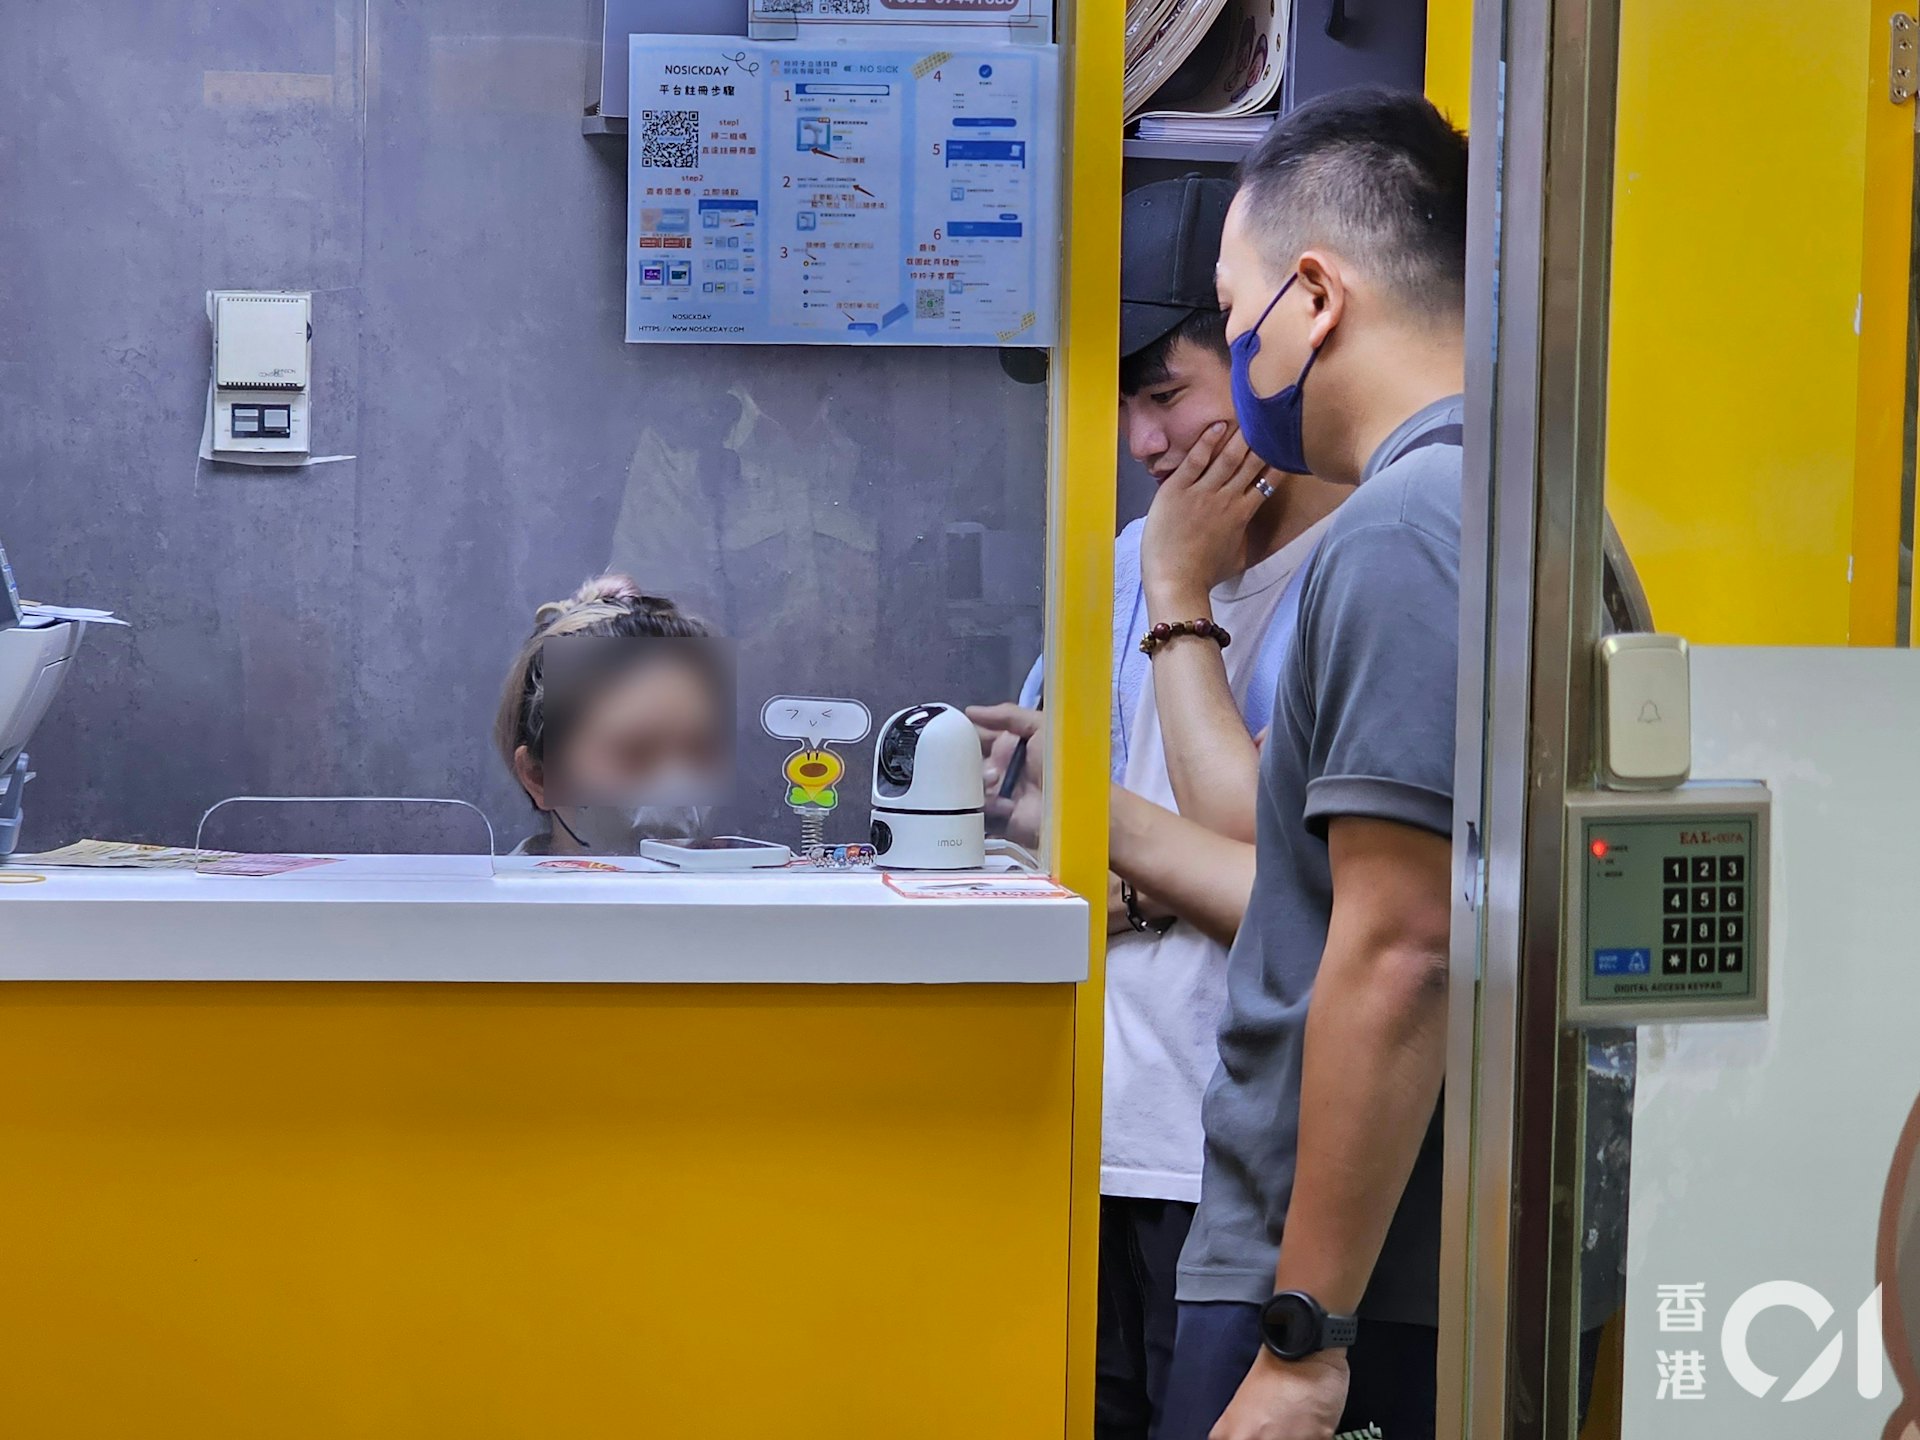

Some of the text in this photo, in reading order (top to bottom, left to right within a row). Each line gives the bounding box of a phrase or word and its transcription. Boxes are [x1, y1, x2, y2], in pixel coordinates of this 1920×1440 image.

[664, 65, 729, 76] NOSICKDAY
[860, 65, 899, 74] NO SICK
[933, 70, 942, 82] 4
[784, 90, 792, 102] 1
[719, 119, 739, 127] step1
[932, 144, 941, 155] 5
[681, 175, 704, 183] step2
[782, 176, 791, 188] 2
[933, 229, 942, 240] 6
[780, 247, 788, 259] 3
[1672, 861, 1737, 878] 1 2 3
[1671, 892, 1736, 908] 4 5 6
[1671, 922, 1736, 939] 7 8 9
[1698, 953, 1708, 968] 0
[1725, 953, 1736, 967] #
